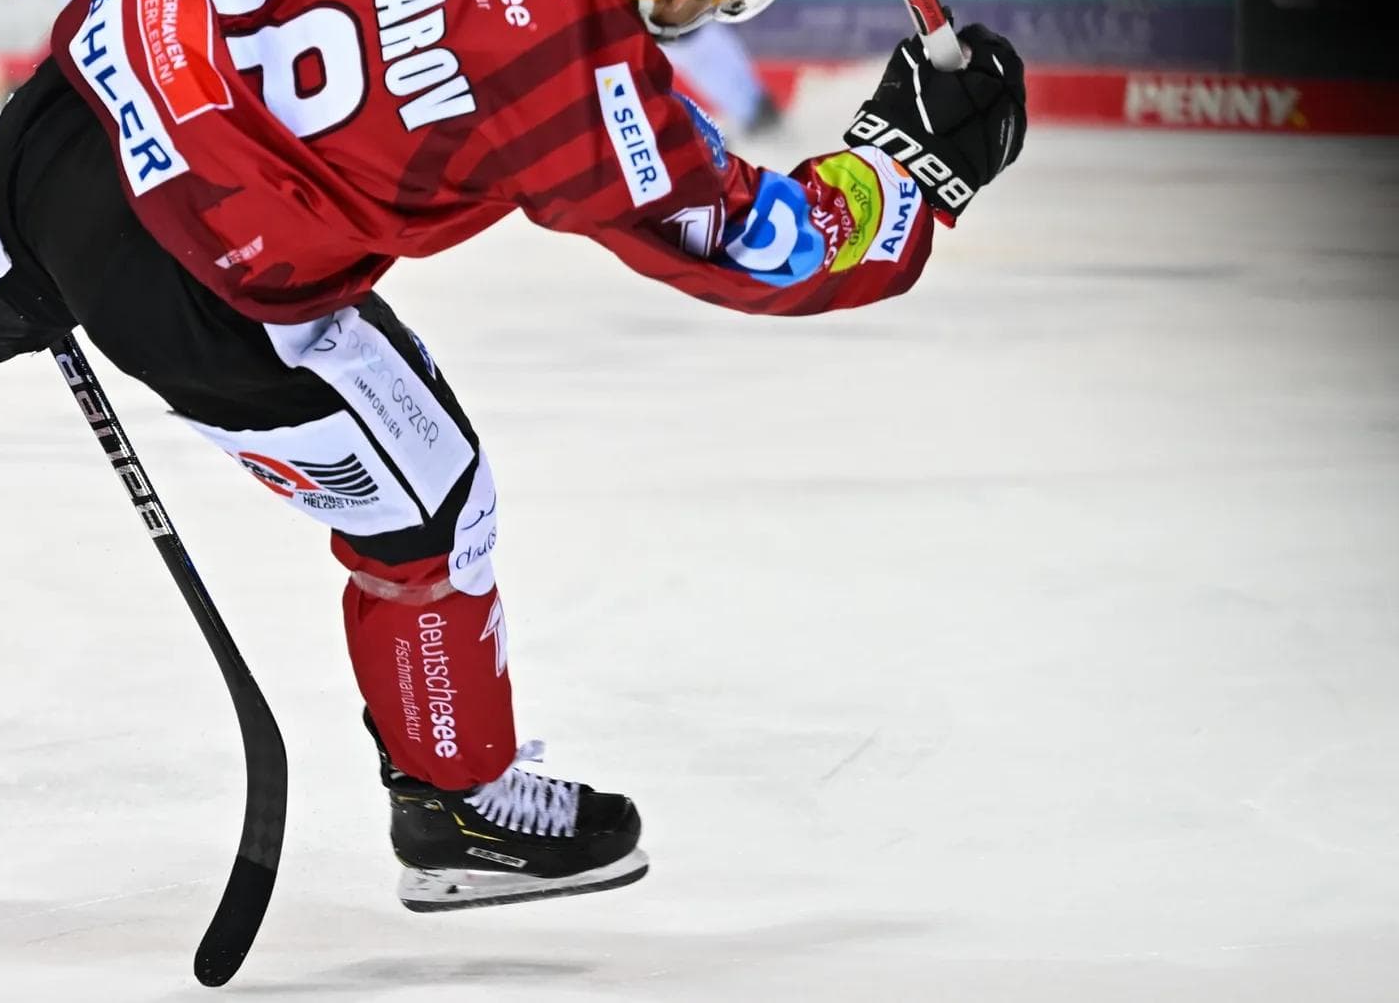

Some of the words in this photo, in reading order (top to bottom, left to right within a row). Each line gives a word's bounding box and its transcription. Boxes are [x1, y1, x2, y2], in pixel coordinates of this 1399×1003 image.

[613, 106, 658, 194] SEIER.
[354, 376, 403, 440] IMMOBILIEN
[393, 637, 424, 743] Fischmanufaktur
[418, 611, 460, 760] deutschesee
